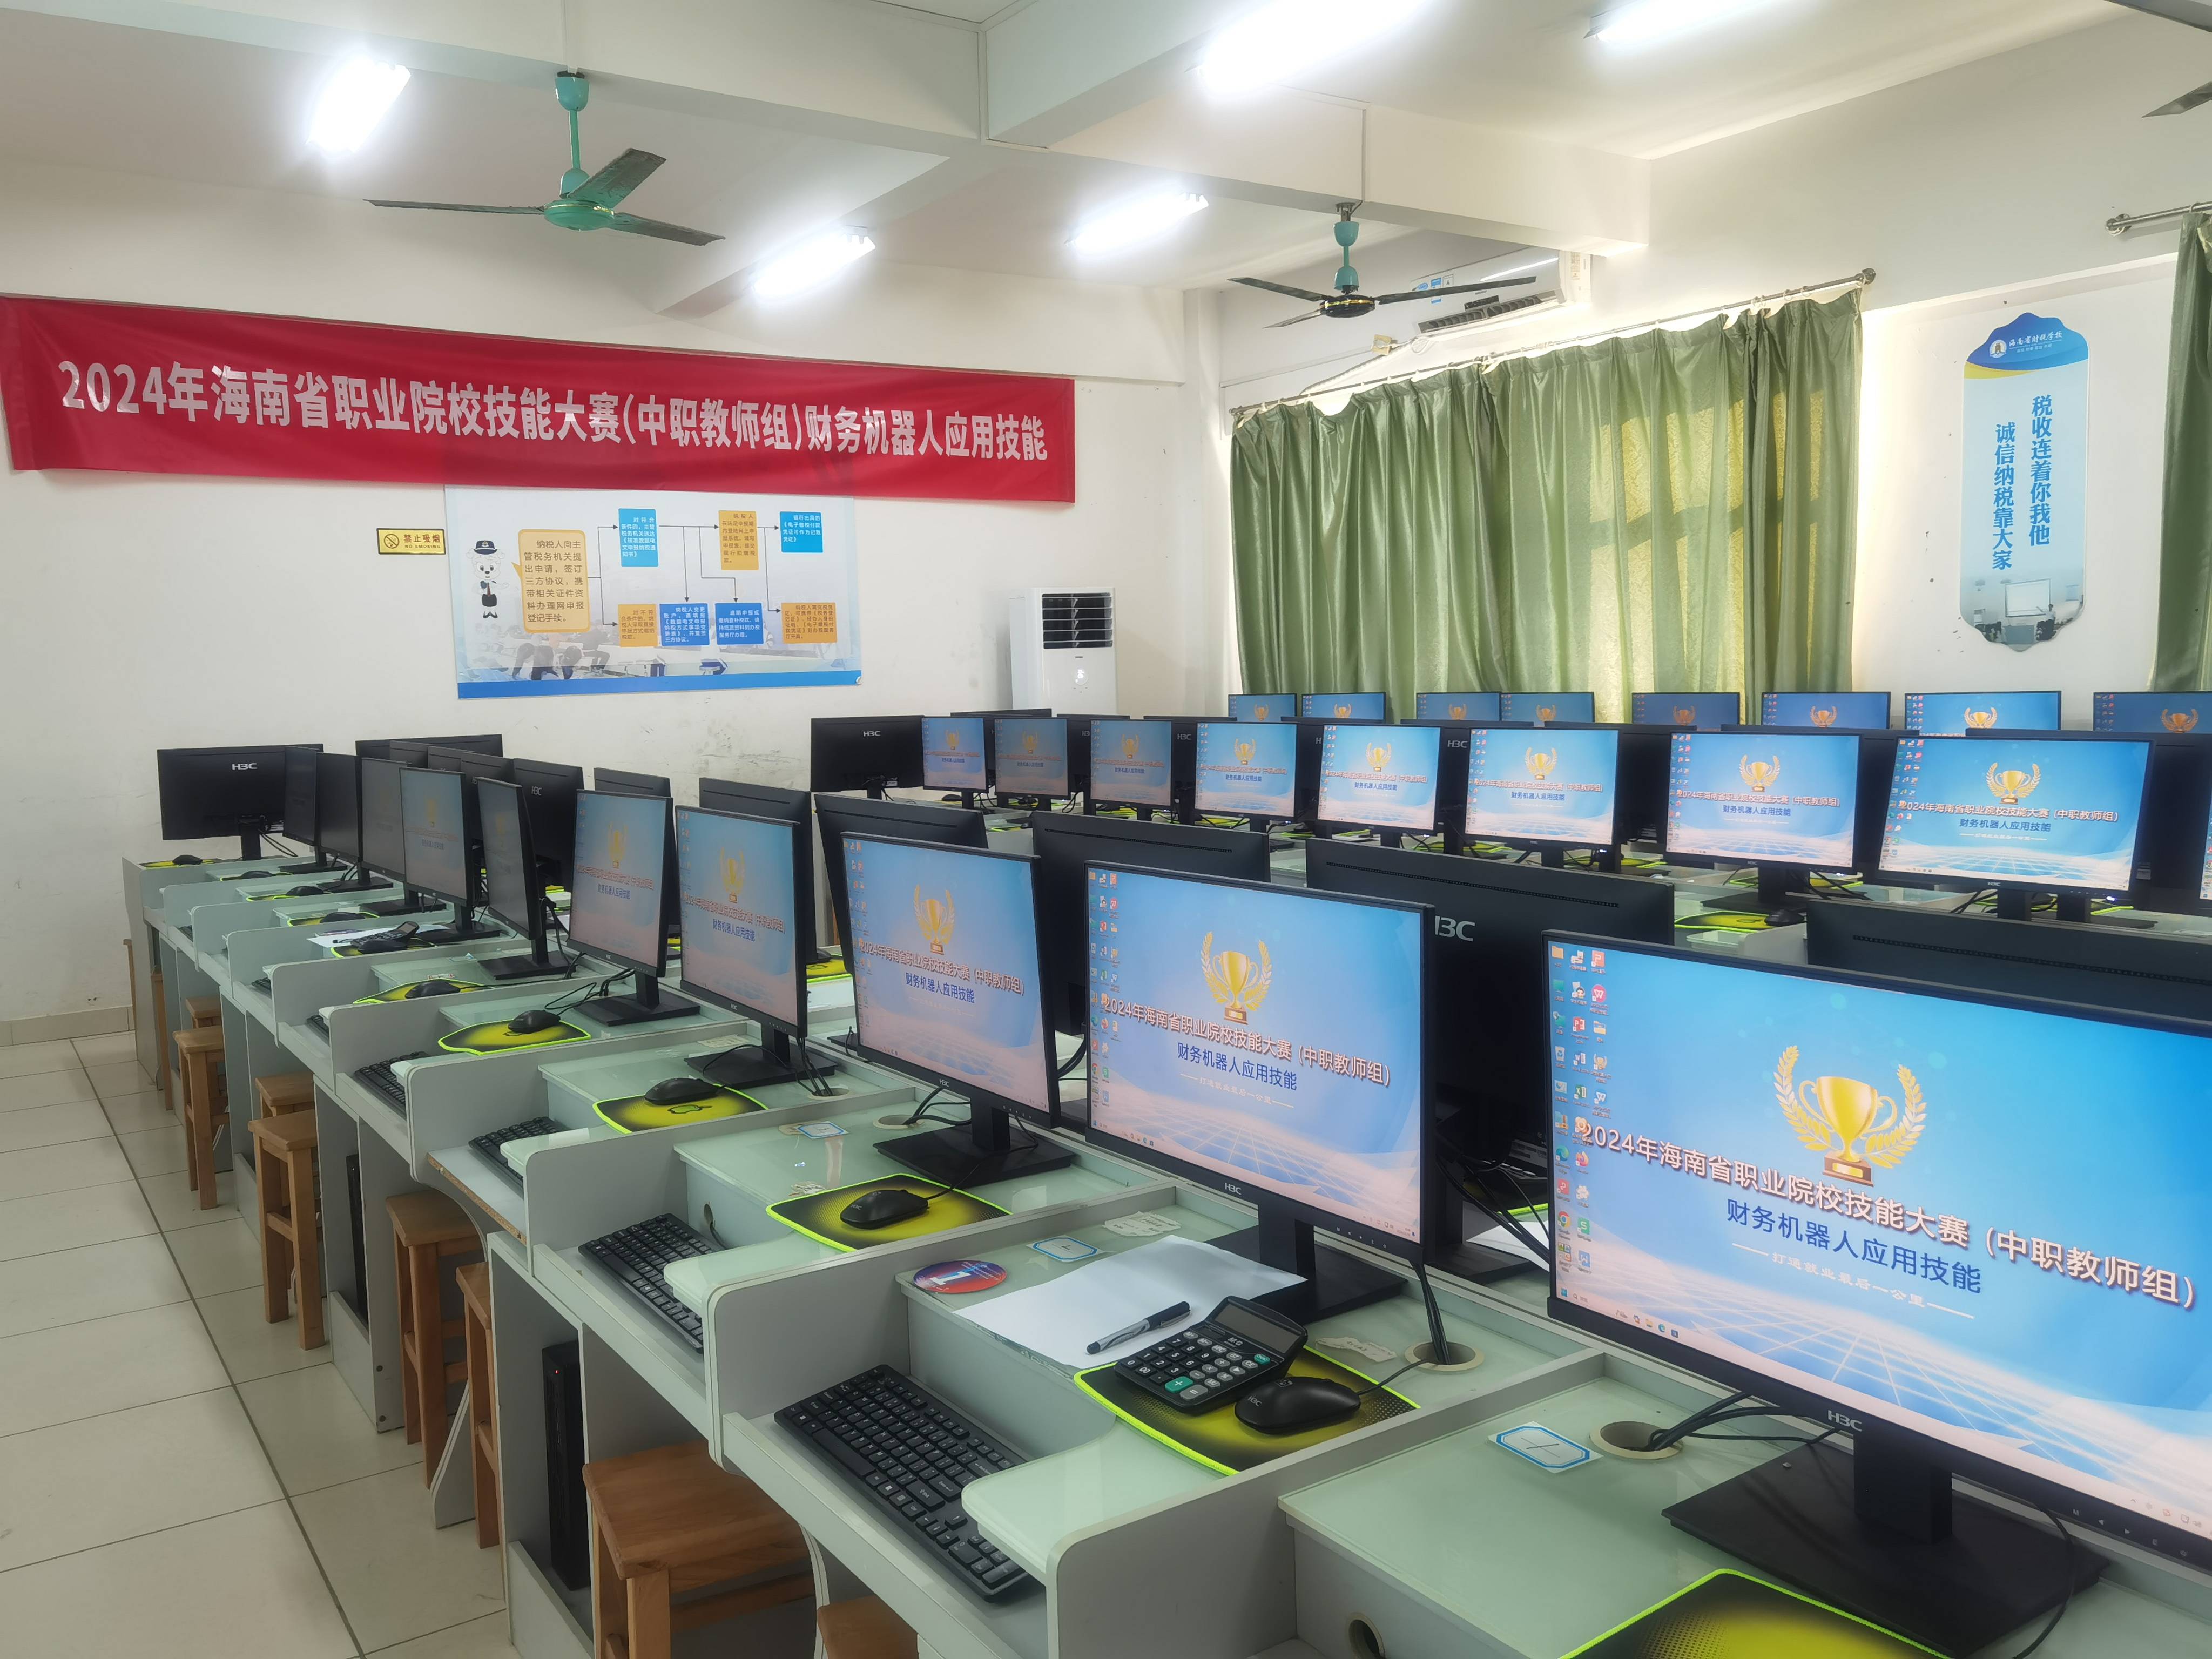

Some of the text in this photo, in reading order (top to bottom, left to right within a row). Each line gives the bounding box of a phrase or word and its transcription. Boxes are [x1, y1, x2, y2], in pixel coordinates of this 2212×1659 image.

[2009, 331, 2062, 347] 海南省财税学校
[59, 360, 1048, 461] 2024年海南省职业院校技能大赛(中职教师组)财务机器人应用技能
[2029, 395, 2053, 546] 税收连着你我他
[1992, 421, 2016, 571] 诚信纳税靠大家
[404, 534, 441, 543] 禁止吸烟
[537, 540, 581, 549] 纳税人向主
[524, 552, 582, 561] 管税务机关提
[525, 565, 582, 574] 出申请，签订
[525, 577, 583, 586] 三方协议，携
[526, 589, 584, 598] 带相关证件资
[527, 601, 585, 610] 料办理网申报
[528, 613, 567, 622] 登记手续。
[1447, 740, 1468, 748] H3C
[232, 762, 258, 771] H3C
[531, 786, 542, 796] H3C
[1510, 791, 1566, 801] 财务机器人应用技能
[1723, 805, 1791, 817] 财务机器人应用技能
[1959, 818, 2052, 832] 财务机器人应用技能
[905, 972, 975, 1004] 财务机器人应用技能
[1103, 998, 1391, 1088] 2024年海南省职业院校技能大赛（中职教师组）
[1177, 1042, 1298, 1091] 财务机器人应用技能
[939, 1078, 950, 1088] H3C
[1224, 1183, 1242, 1195] H3C
[1581, 1119, 2197, 1309] 2024年海南省职业院校技能大赛（中职教师组）
[1726, 1197, 1982, 1294] 财务机器人应用技能
[1247, 1395, 1262, 1407] H3C
[1826, 1408, 1863, 1432] H3C
